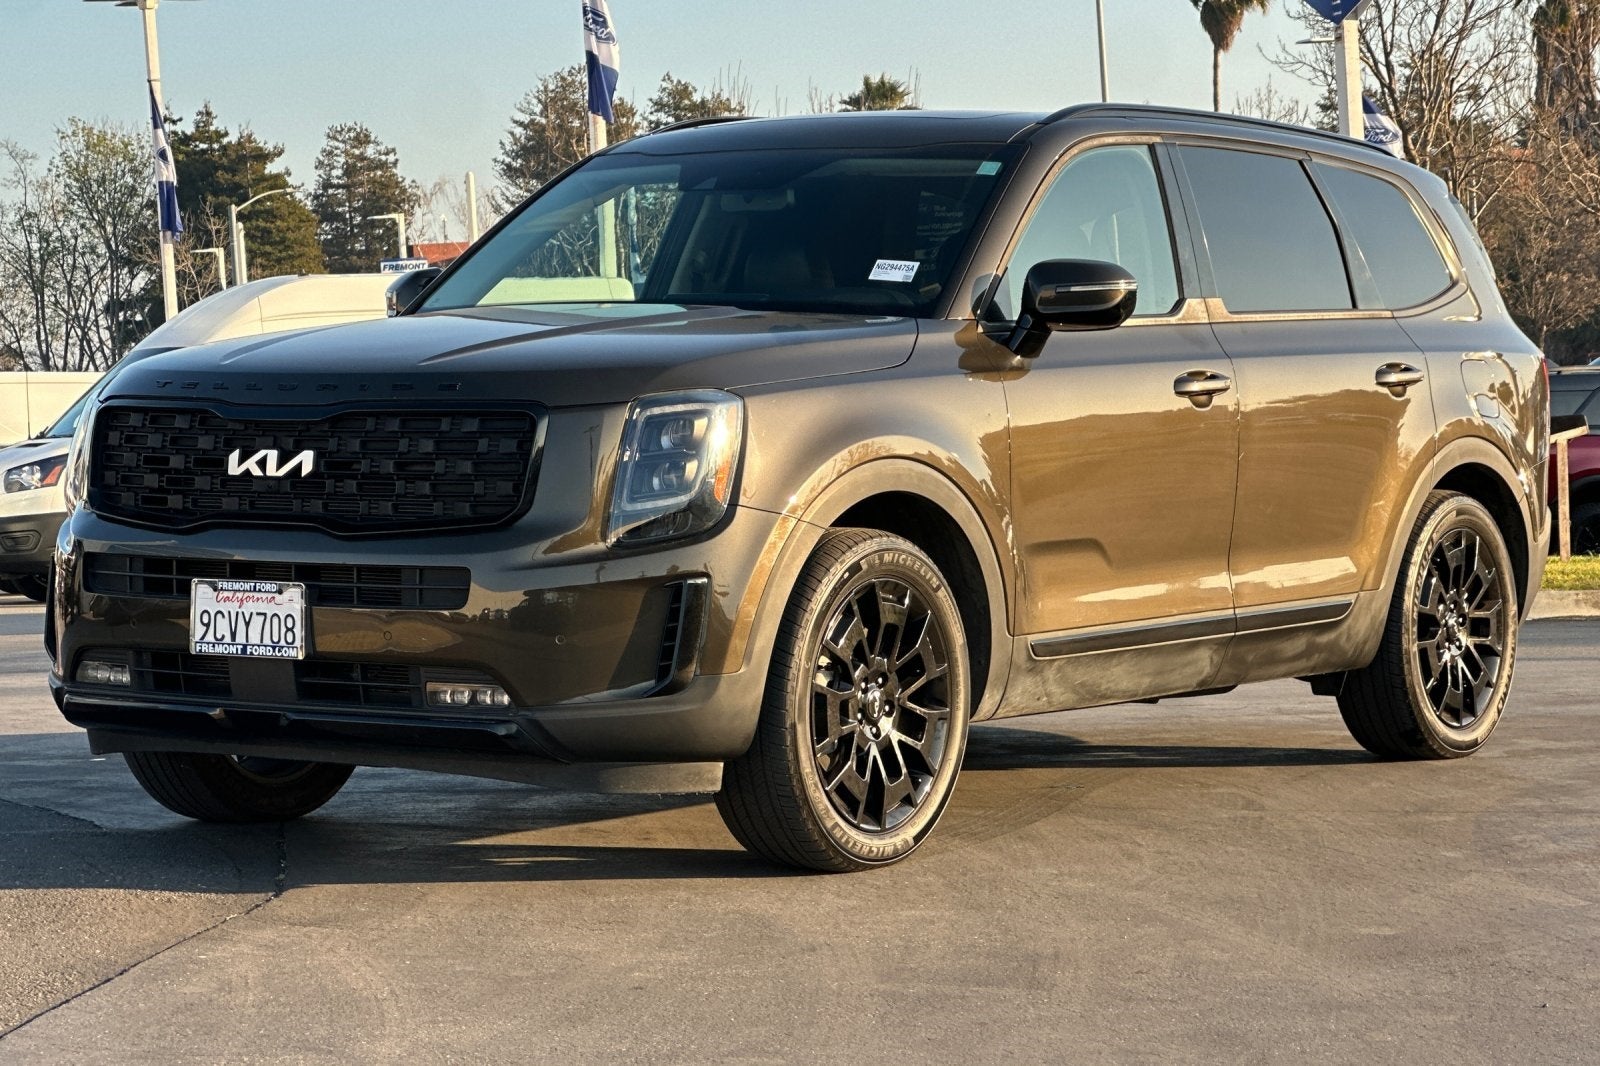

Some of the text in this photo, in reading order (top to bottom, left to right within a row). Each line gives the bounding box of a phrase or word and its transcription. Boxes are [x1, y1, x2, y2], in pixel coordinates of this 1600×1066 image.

[1364, 128, 1394, 142] Ford
[382, 262, 426, 272] FREMONT
[156, 379, 463, 392] TELLURIDE
[882, 552, 941, 590] MICHELIN
[218, 581, 277, 592] FREMONT FORD
[216, 591, 283, 608] California
[199, 609, 296, 646] 9CVY708
[195, 642, 298, 657] FREMONT FORD.COM
[831, 828, 895, 857] MICHELIN
